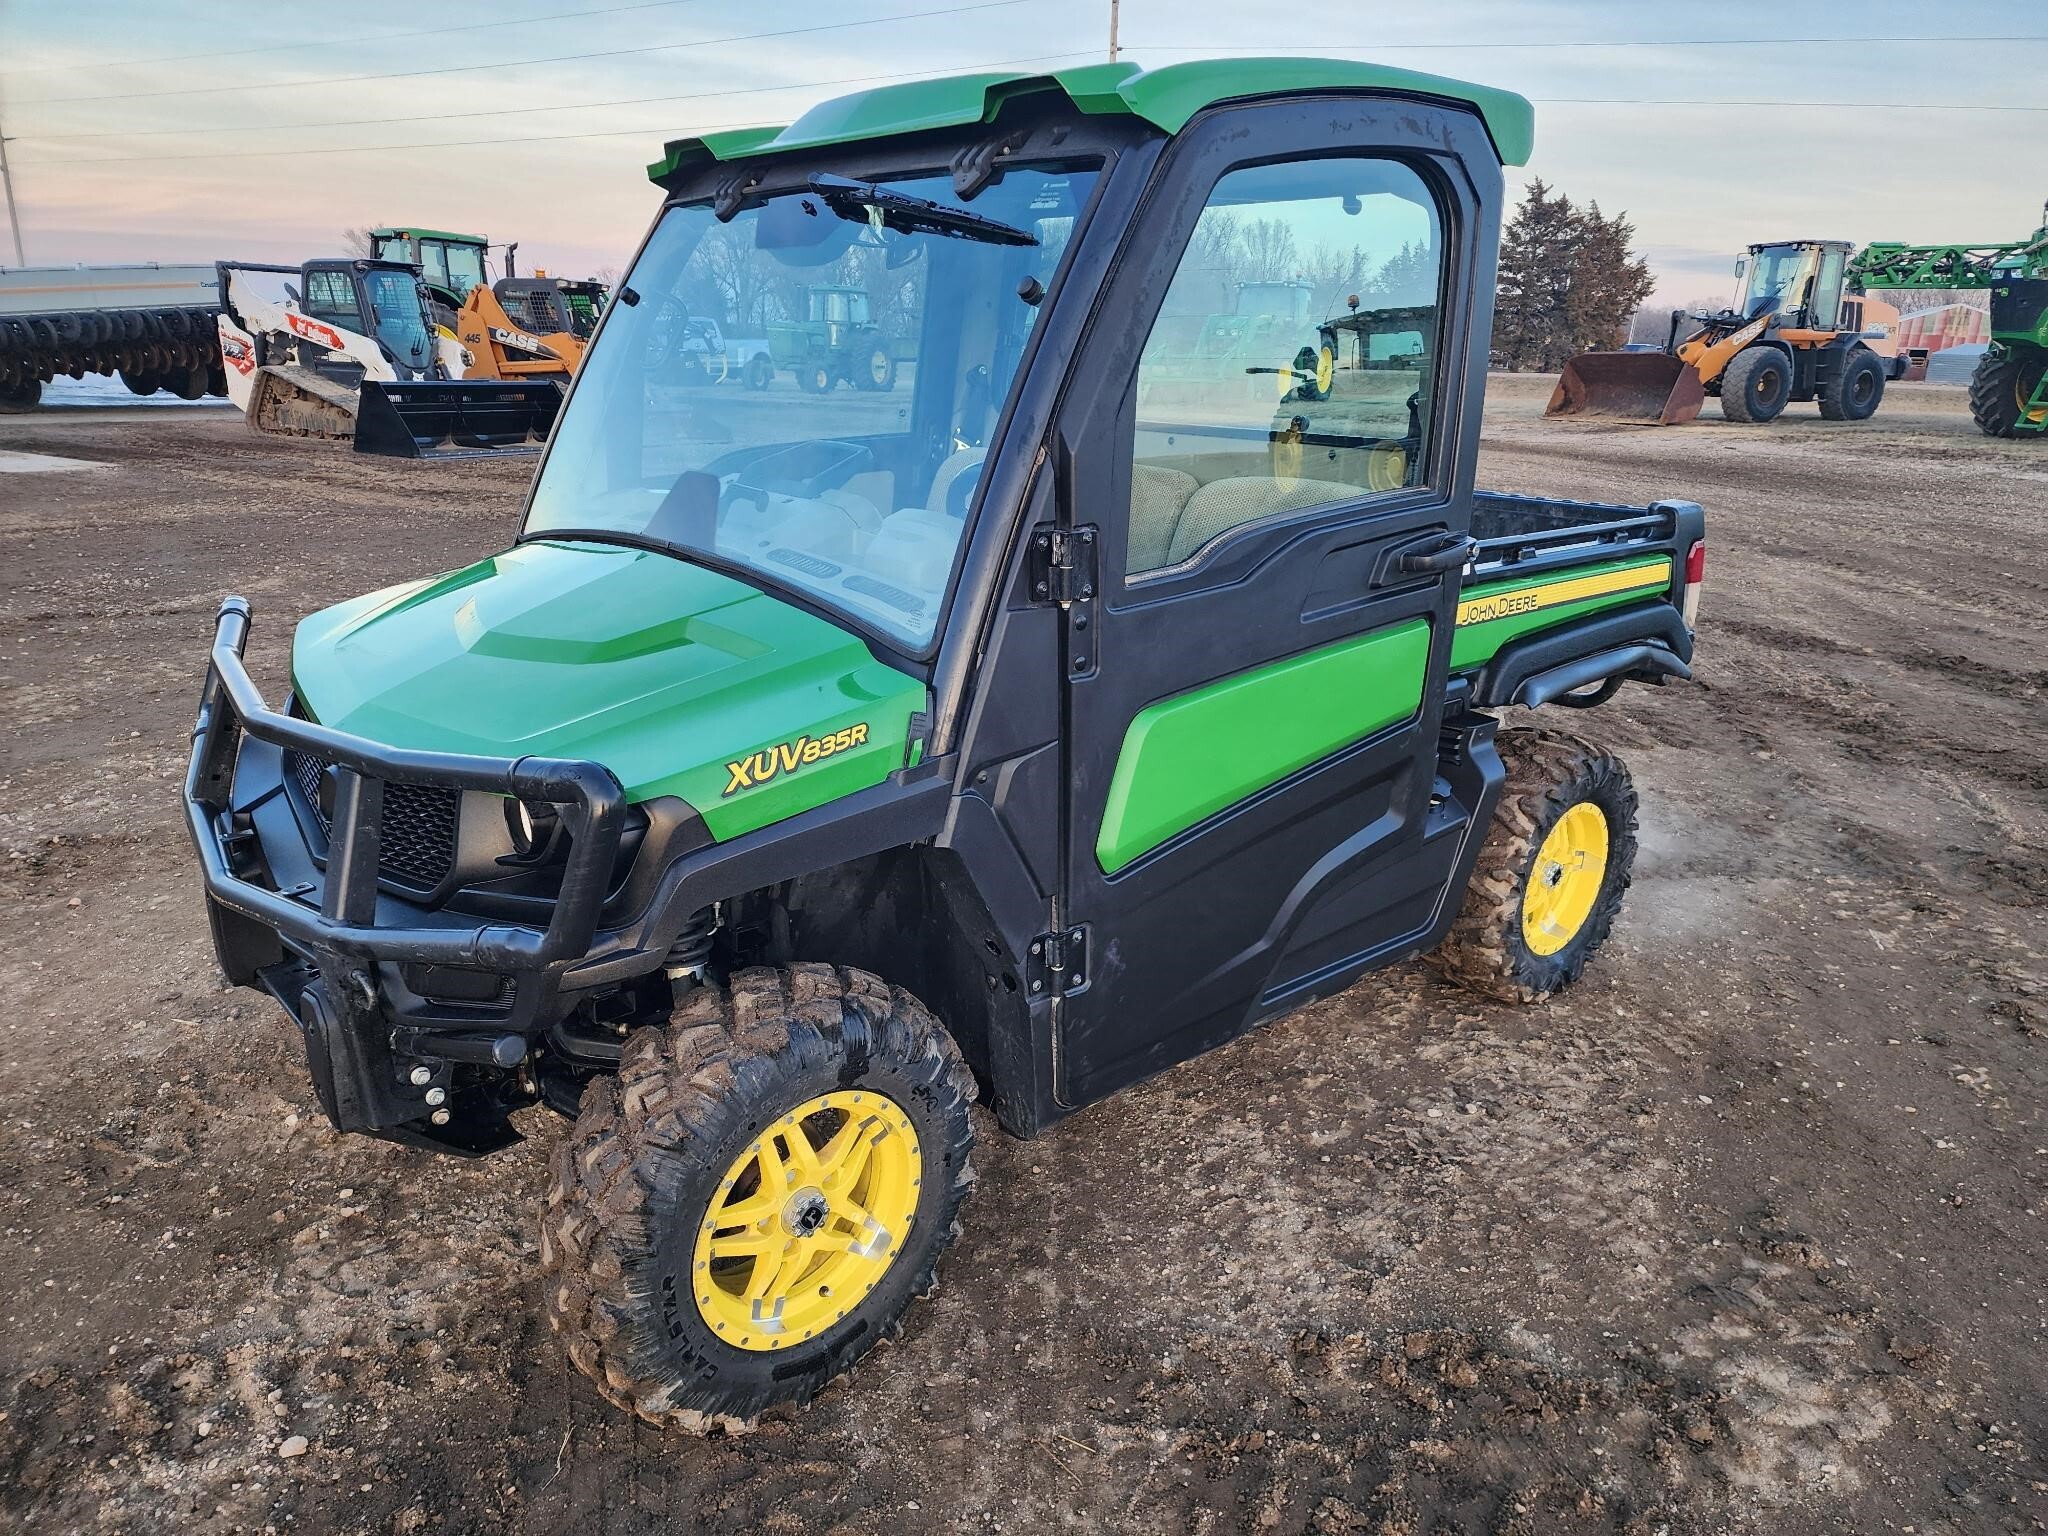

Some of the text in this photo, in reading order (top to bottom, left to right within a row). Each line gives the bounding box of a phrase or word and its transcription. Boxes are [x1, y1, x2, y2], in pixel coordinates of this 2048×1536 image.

[464, 333, 481, 344] 445
[495, 327, 539, 352] CASE
[1732, 319, 1764, 346] CASE
[1462, 594, 1539, 626] JOHN DEERE
